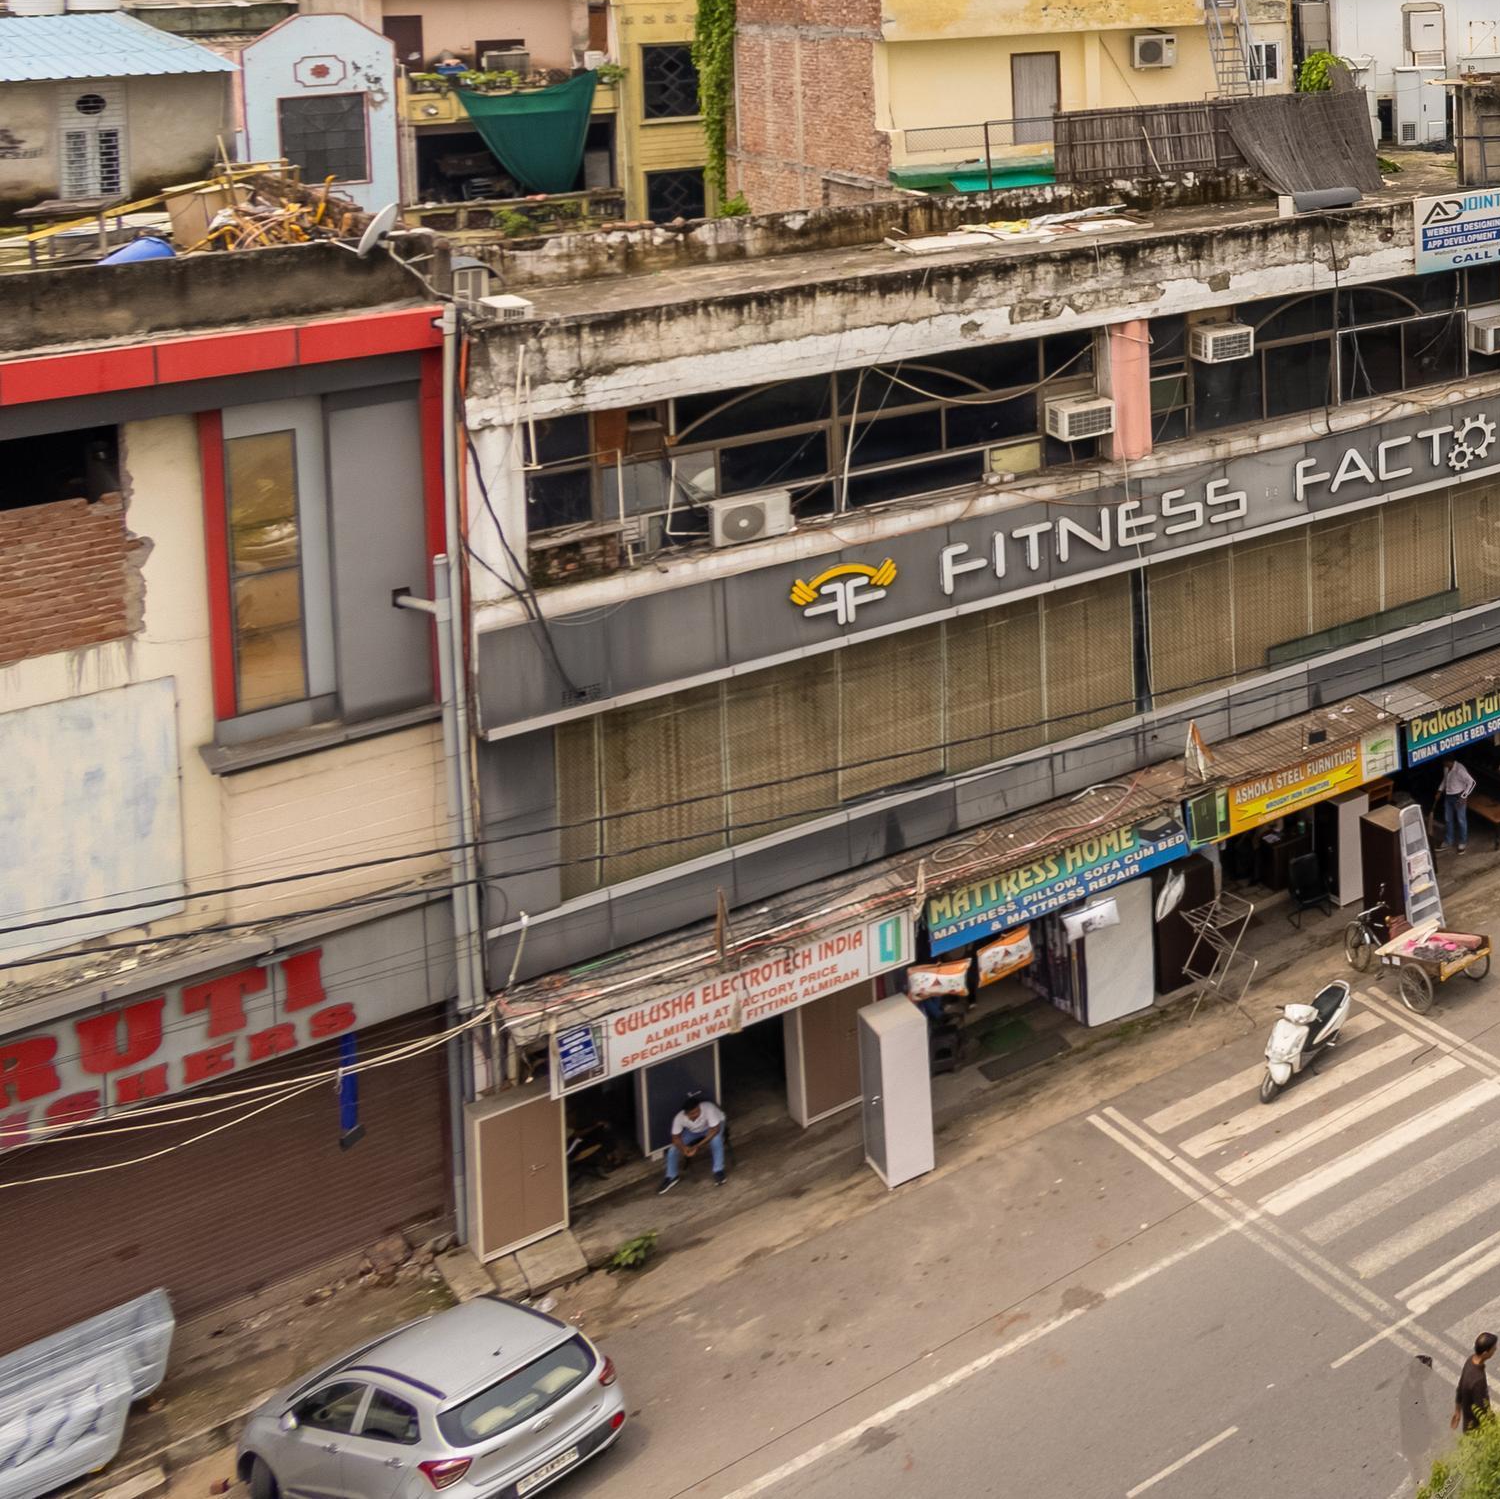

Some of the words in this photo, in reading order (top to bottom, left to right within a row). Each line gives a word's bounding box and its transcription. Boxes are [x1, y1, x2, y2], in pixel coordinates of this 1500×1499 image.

[1426, 224, 1462, 237] WEBSITE
[1427, 239, 1443, 249] APP
[1444, 231, 1497, 246] DEVELOPMENT
[1452, 251, 1492, 264] CALL
[939, 478, 1248, 596] FITNESS
[1411, 702, 1472, 743] Prakash
[1412, 743, 1439, 762] DIWAN,
[1440, 732, 1469, 752] DOUBLE
[1470, 725, 1487, 739] BED,
[1235, 780, 1274, 805] ASHOKA
[1276, 767, 1305, 789] STEEL
[1306, 747, 1357, 777] FURNITURE
[931, 856, 1060, 925] MATTRESS
[1064, 826, 1136, 873] HOME
[1084, 860, 1121, 882] SOFA
[1124, 845, 1154, 865] CUM
[1158, 834, 1185, 851] BED
[991, 921, 1002, 932] &
[1007, 887, 1086, 924] MATTRESS
[1089, 864, 1140, 892] REPAIR
[614, 991, 695, 1036] GULUSHA
[702, 949, 812, 1004] ELECTROTECH
[818, 929, 863, 961] INDIA
[645, 1014, 710, 1045] ALMIRAH
[713, 1007, 729, 1022] AT
[799, 964, 838, 987] PRICE
[621, 1039, 682, 1068] SPECIAL
[686, 1031, 701, 1047] IN
[704, 1014, 738, 1037] WAL
[746, 992, 798, 1019] FITTING
[802, 969, 860, 1000] ALMIRAH
